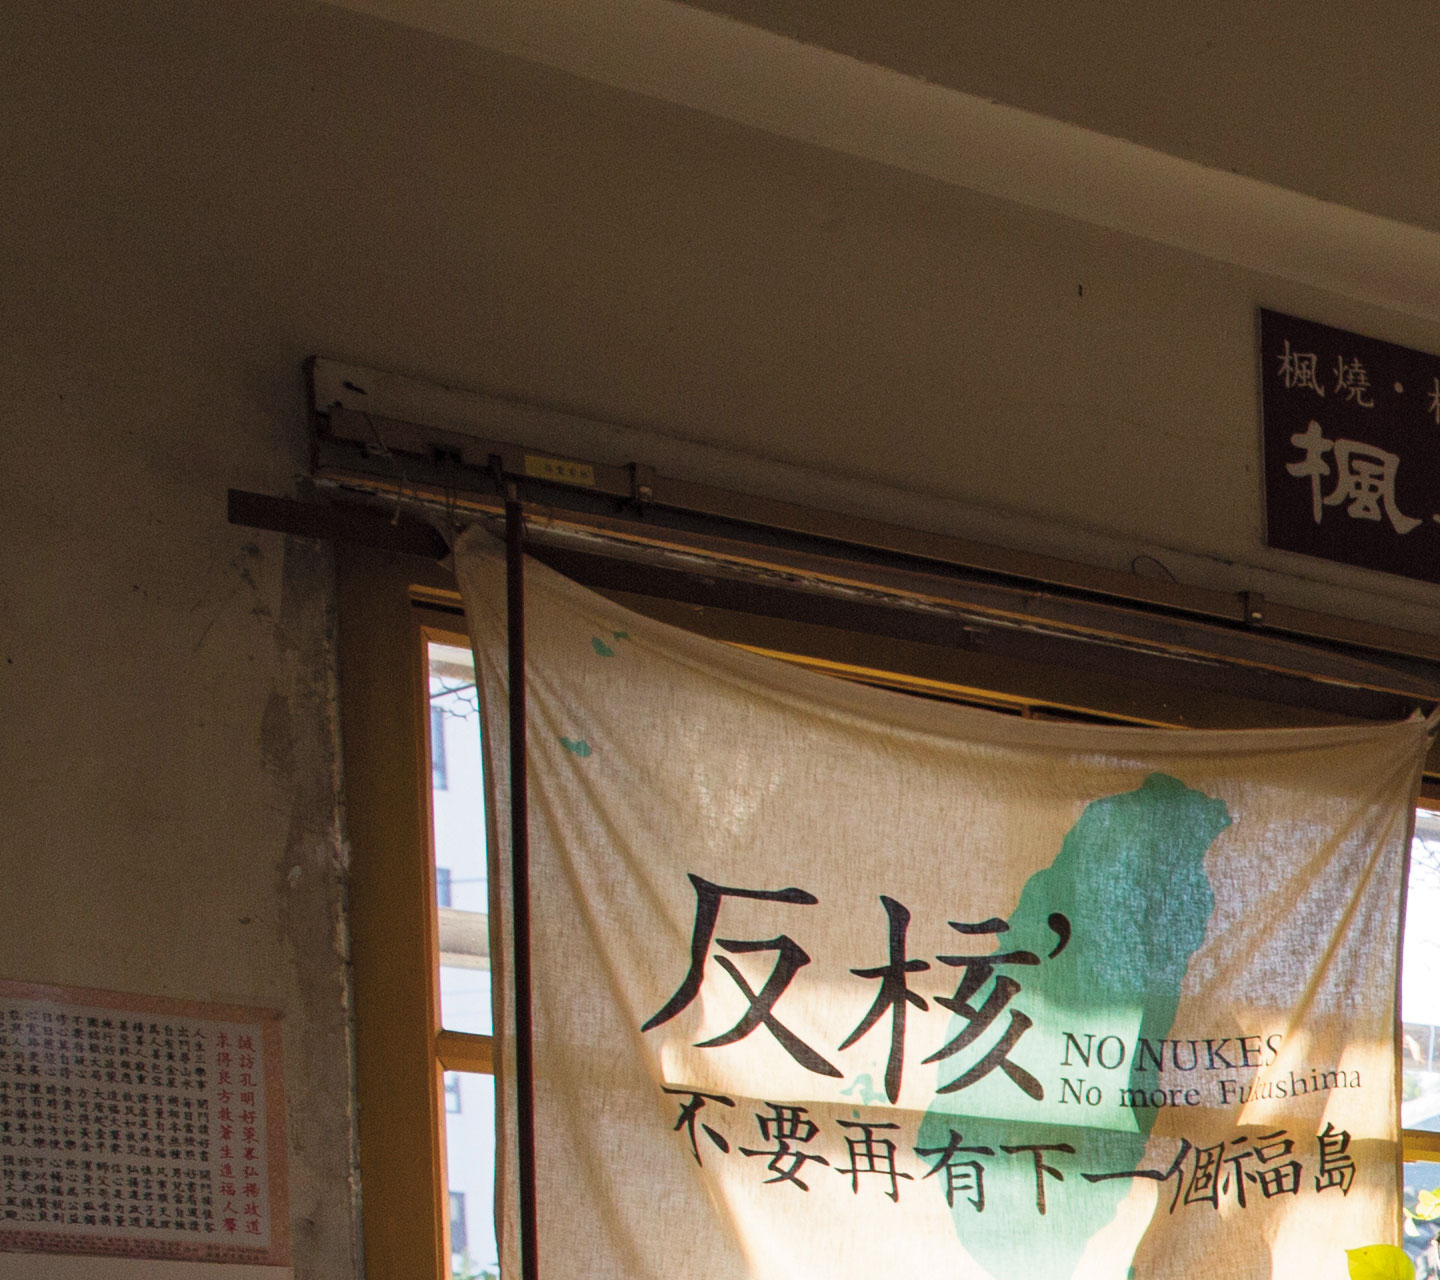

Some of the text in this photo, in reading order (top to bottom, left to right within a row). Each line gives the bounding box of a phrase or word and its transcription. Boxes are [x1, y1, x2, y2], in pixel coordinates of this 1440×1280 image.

[1060, 1031, 1286, 1073] NO NUKES
[1059, 1077, 1103, 1107] No
[1119, 1082, 1202, 1110] more
[661, 1085, 1358, 1216] 不要再有下一個福島
